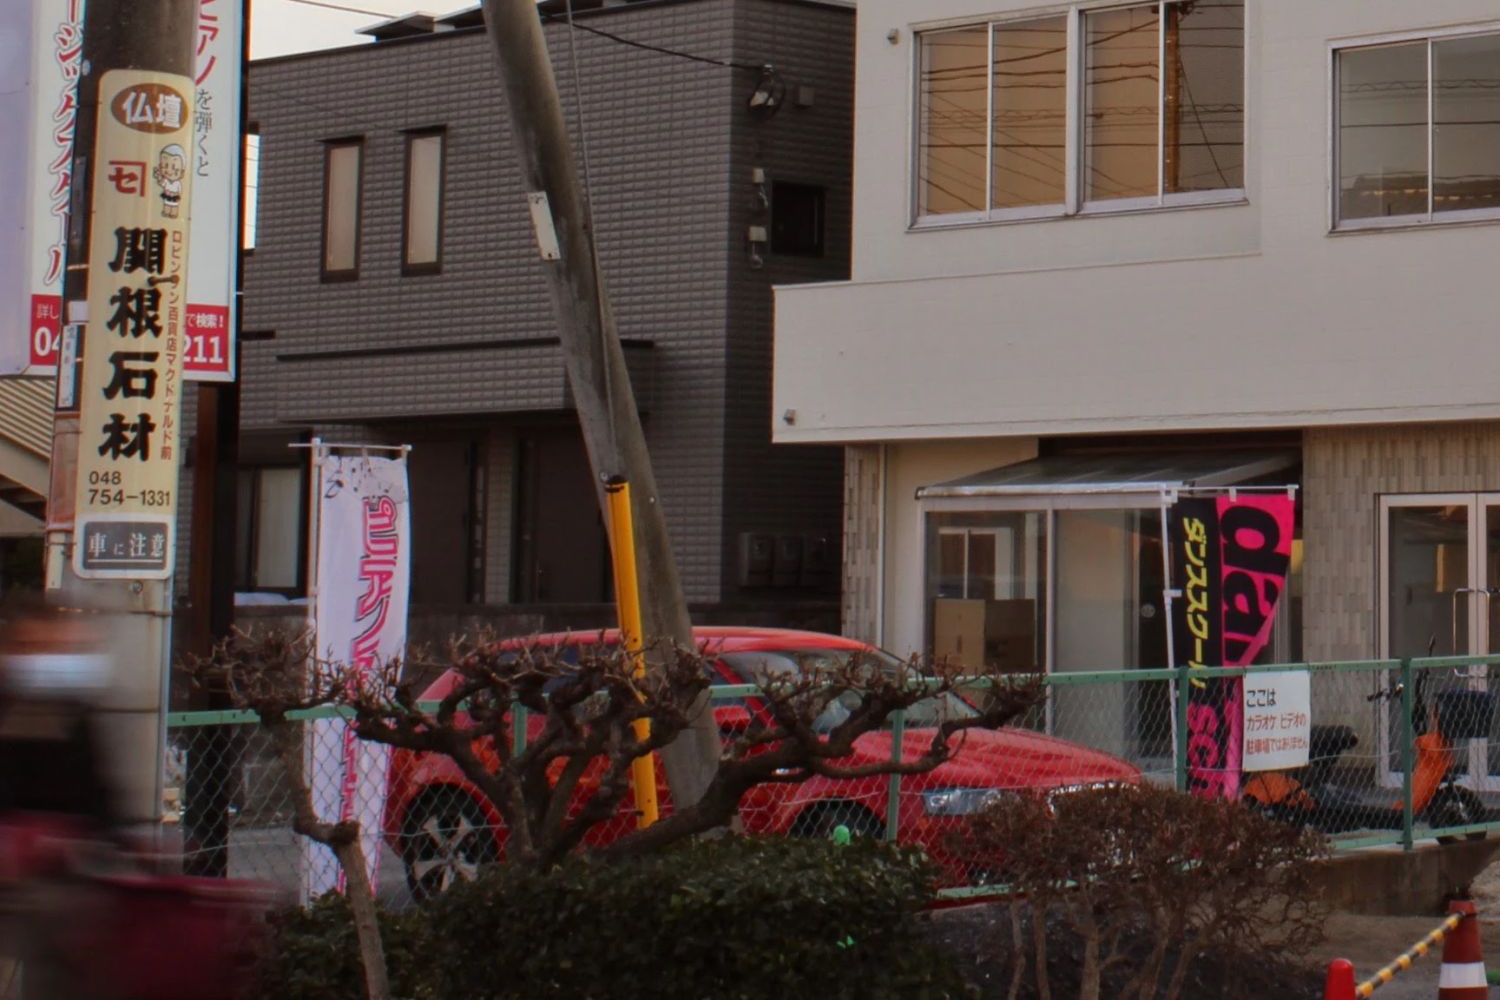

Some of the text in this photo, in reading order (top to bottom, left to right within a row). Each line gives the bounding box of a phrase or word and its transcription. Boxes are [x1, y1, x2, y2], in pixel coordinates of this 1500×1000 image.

[122, 91, 181, 129] 仏壇
[98, 226, 168, 462] 関根石材
[89, 471, 122, 485] 048
[88, 489, 170, 506] 754-1331
[89, 533, 165, 557] 車に注意
[1246, 688, 1276, 707] ここは
